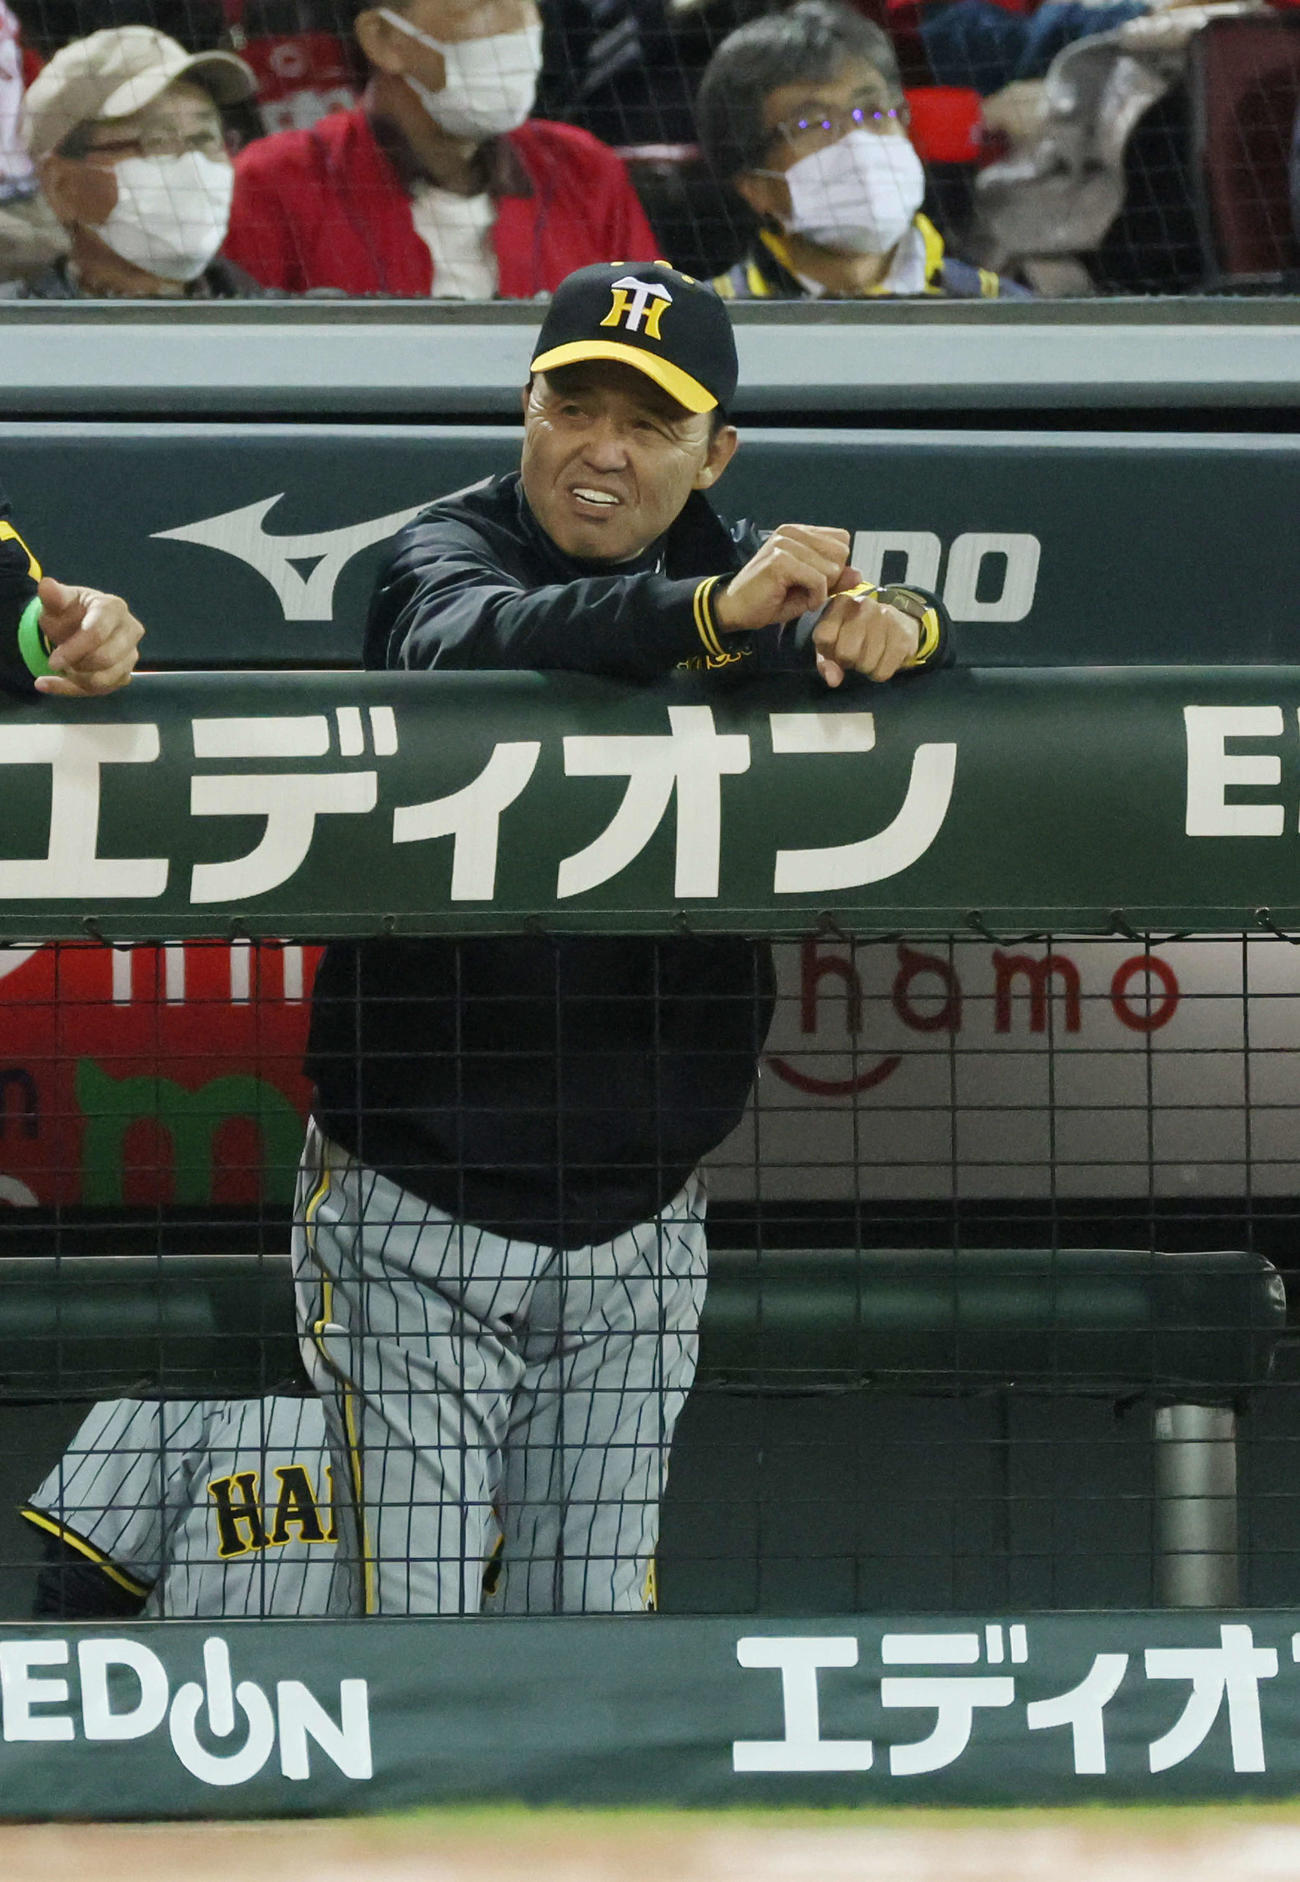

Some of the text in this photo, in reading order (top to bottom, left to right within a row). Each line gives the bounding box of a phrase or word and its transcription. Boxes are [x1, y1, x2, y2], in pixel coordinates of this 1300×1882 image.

[0, 704, 957, 904] エディオン
[1183, 705, 1300, 836] E
[207, 1464, 338, 1559] HA
[733, 1624, 1300, 1776] エディオ
